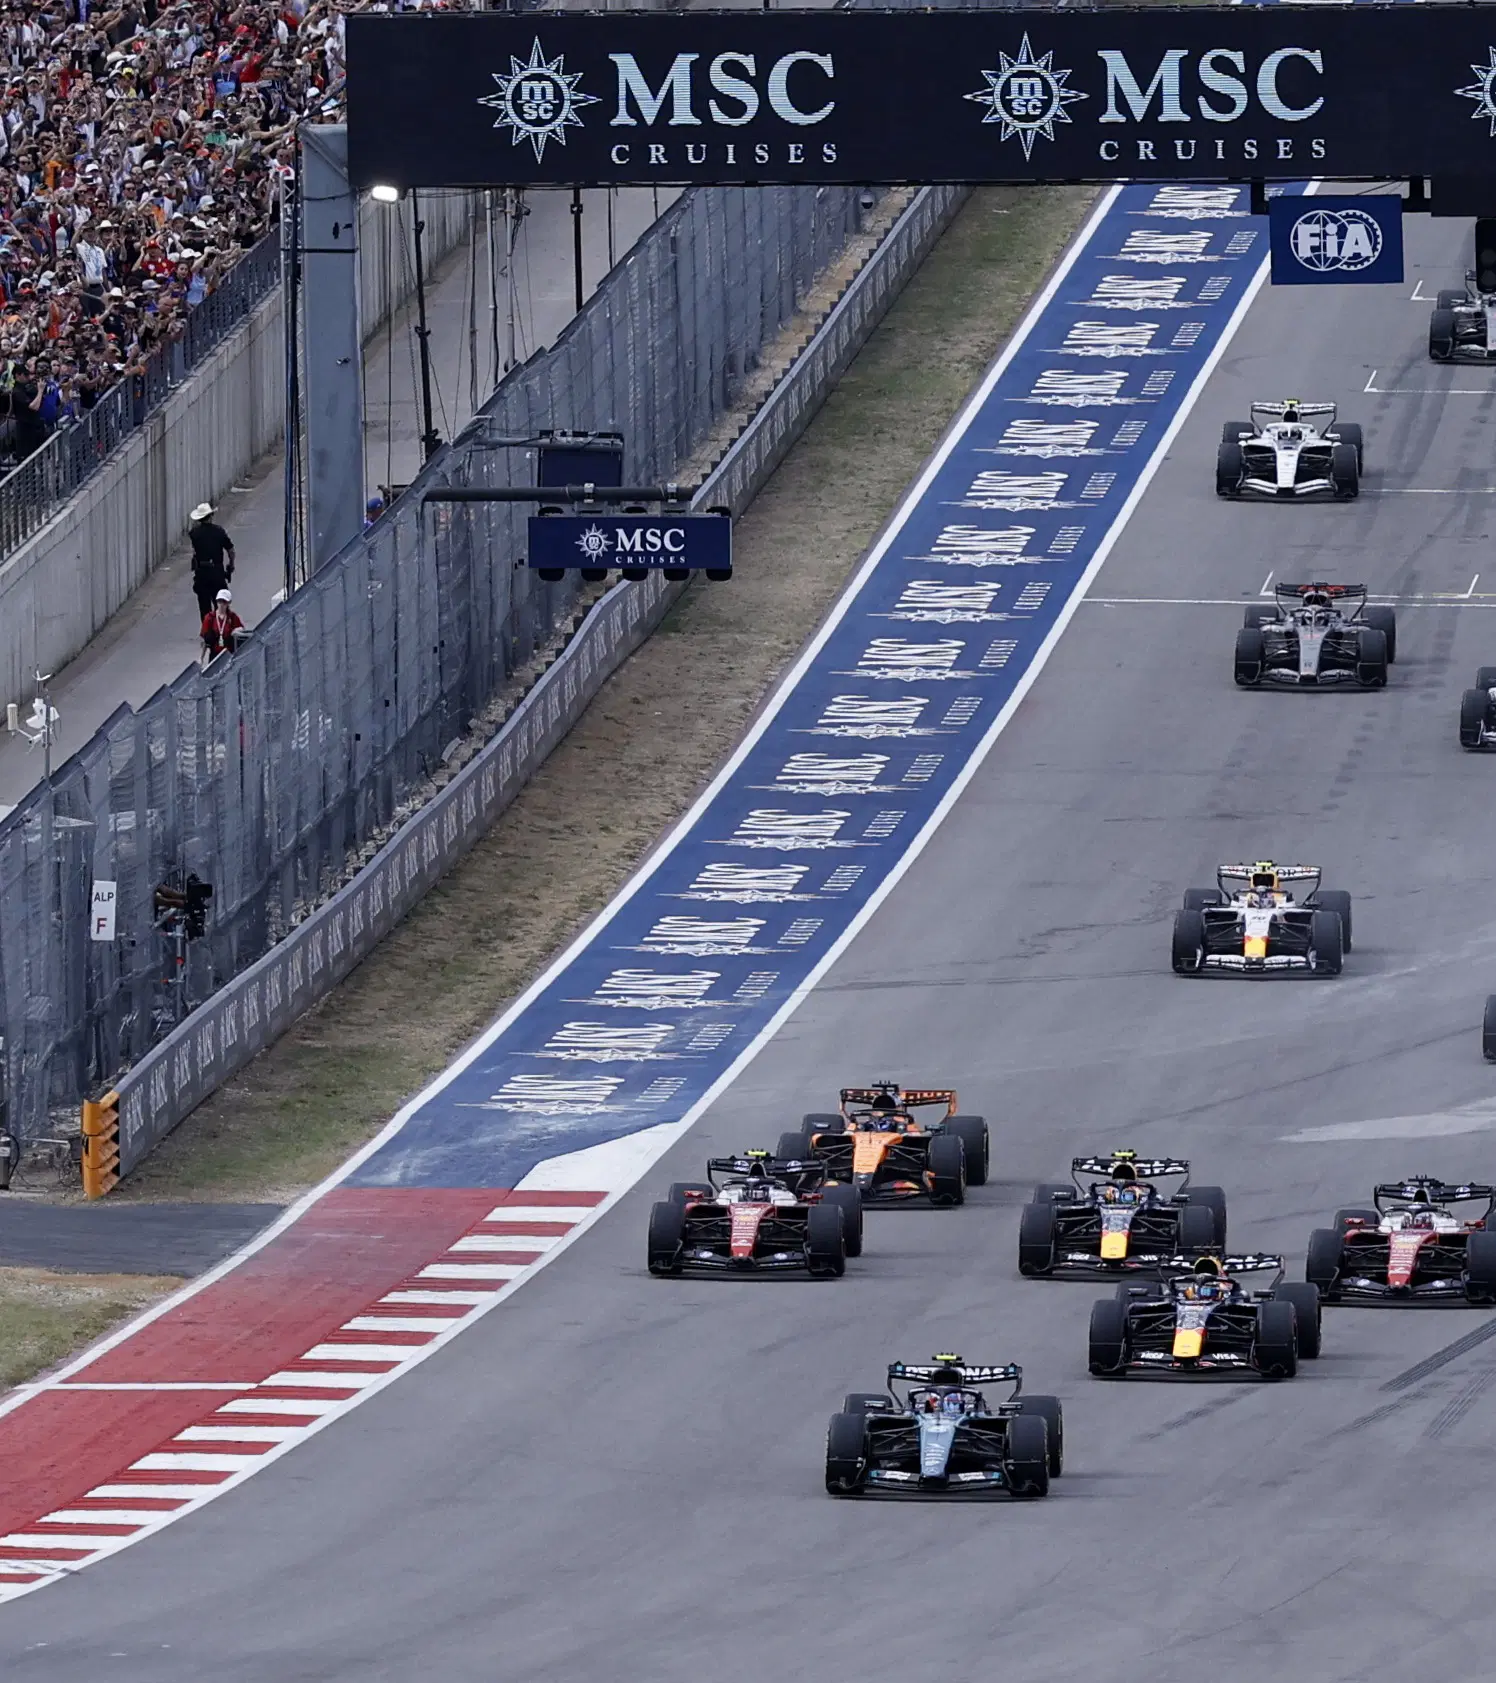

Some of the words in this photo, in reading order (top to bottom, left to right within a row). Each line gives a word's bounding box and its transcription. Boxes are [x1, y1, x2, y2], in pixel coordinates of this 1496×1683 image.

[609, 52, 834, 127] MSC
[1098, 49, 1324, 123] MSC
[611, 145, 836, 165] CRUISES
[1100, 140, 1325, 161] CRUISES
[615, 528, 685, 552] MSC
[615, 556, 686, 564] CRUISES
[94, 892, 114, 902] ALP
[96, 918, 107, 934] F
